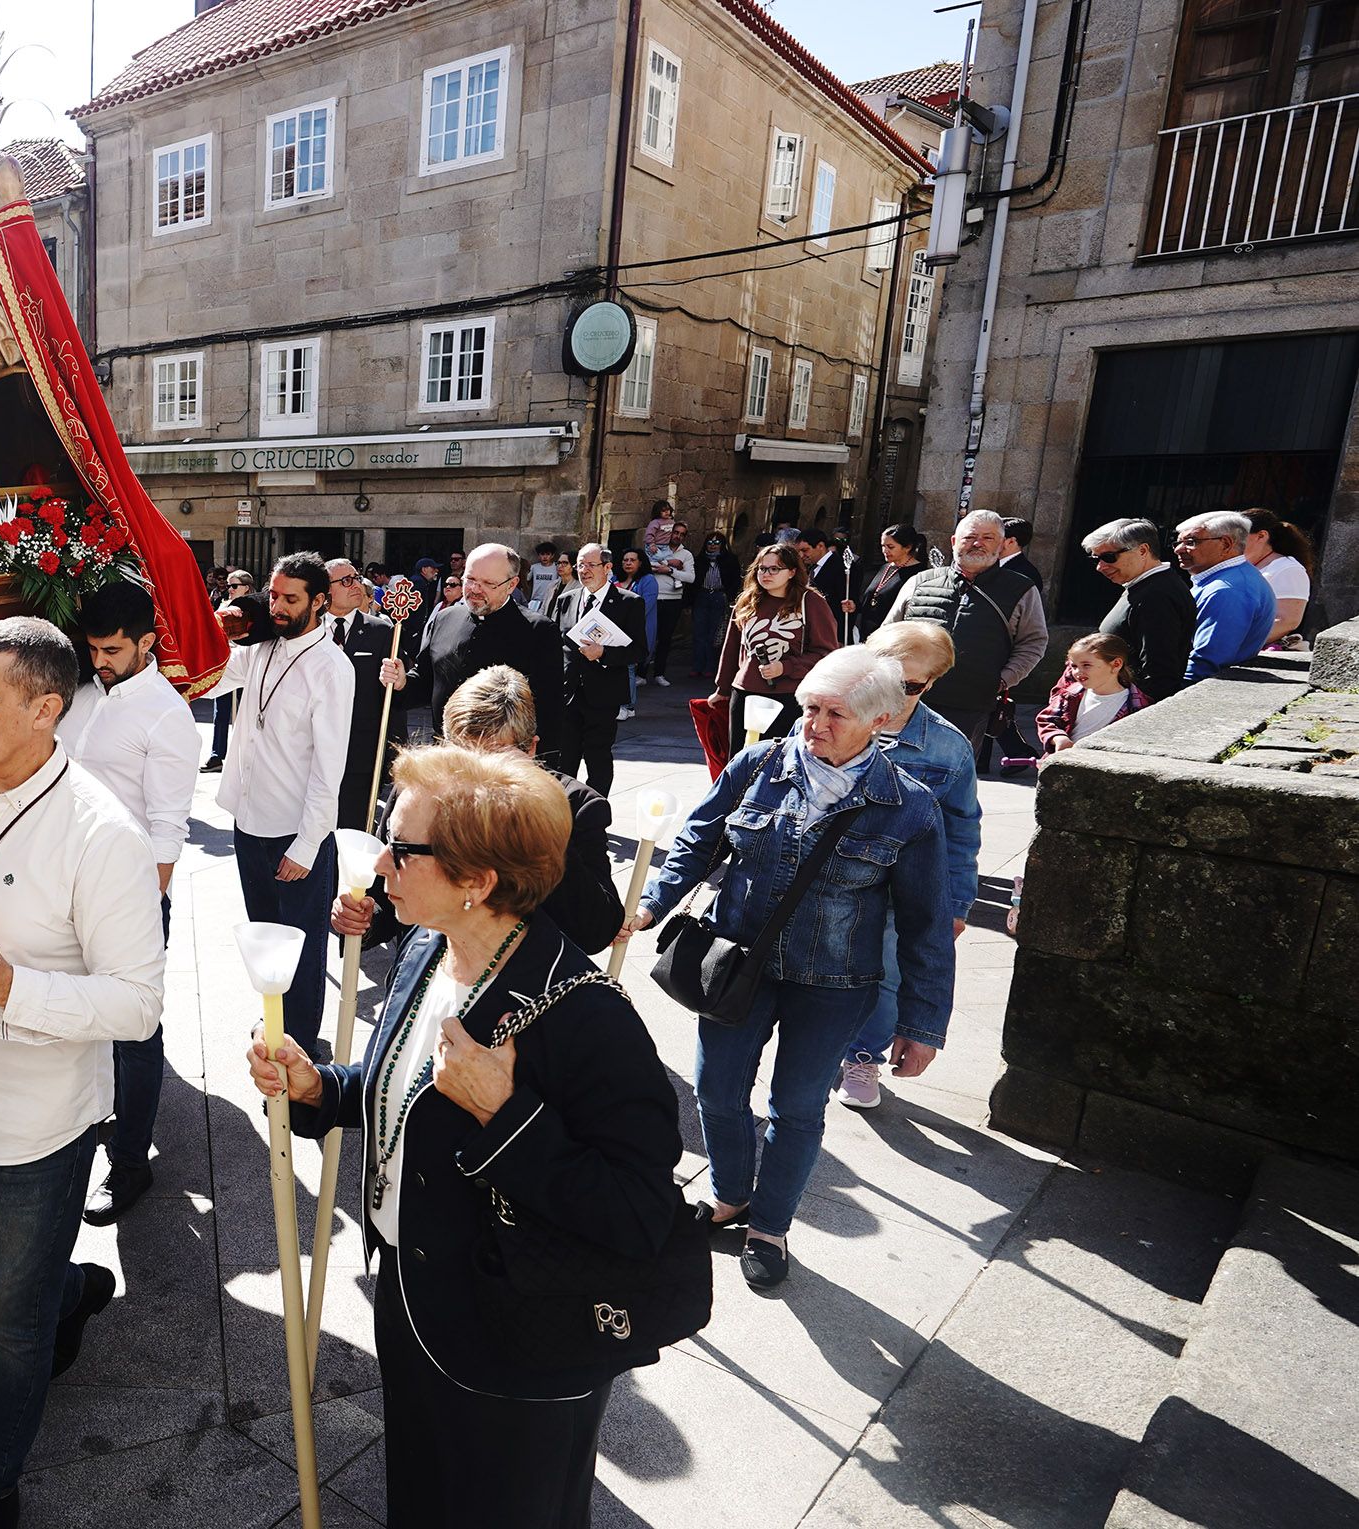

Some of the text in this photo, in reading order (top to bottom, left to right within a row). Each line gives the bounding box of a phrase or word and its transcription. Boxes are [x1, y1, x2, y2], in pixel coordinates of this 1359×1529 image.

[231, 451, 246, 470] O
[252, 447, 355, 470] CRUCEIRO
[369, 447, 420, 464] asador
